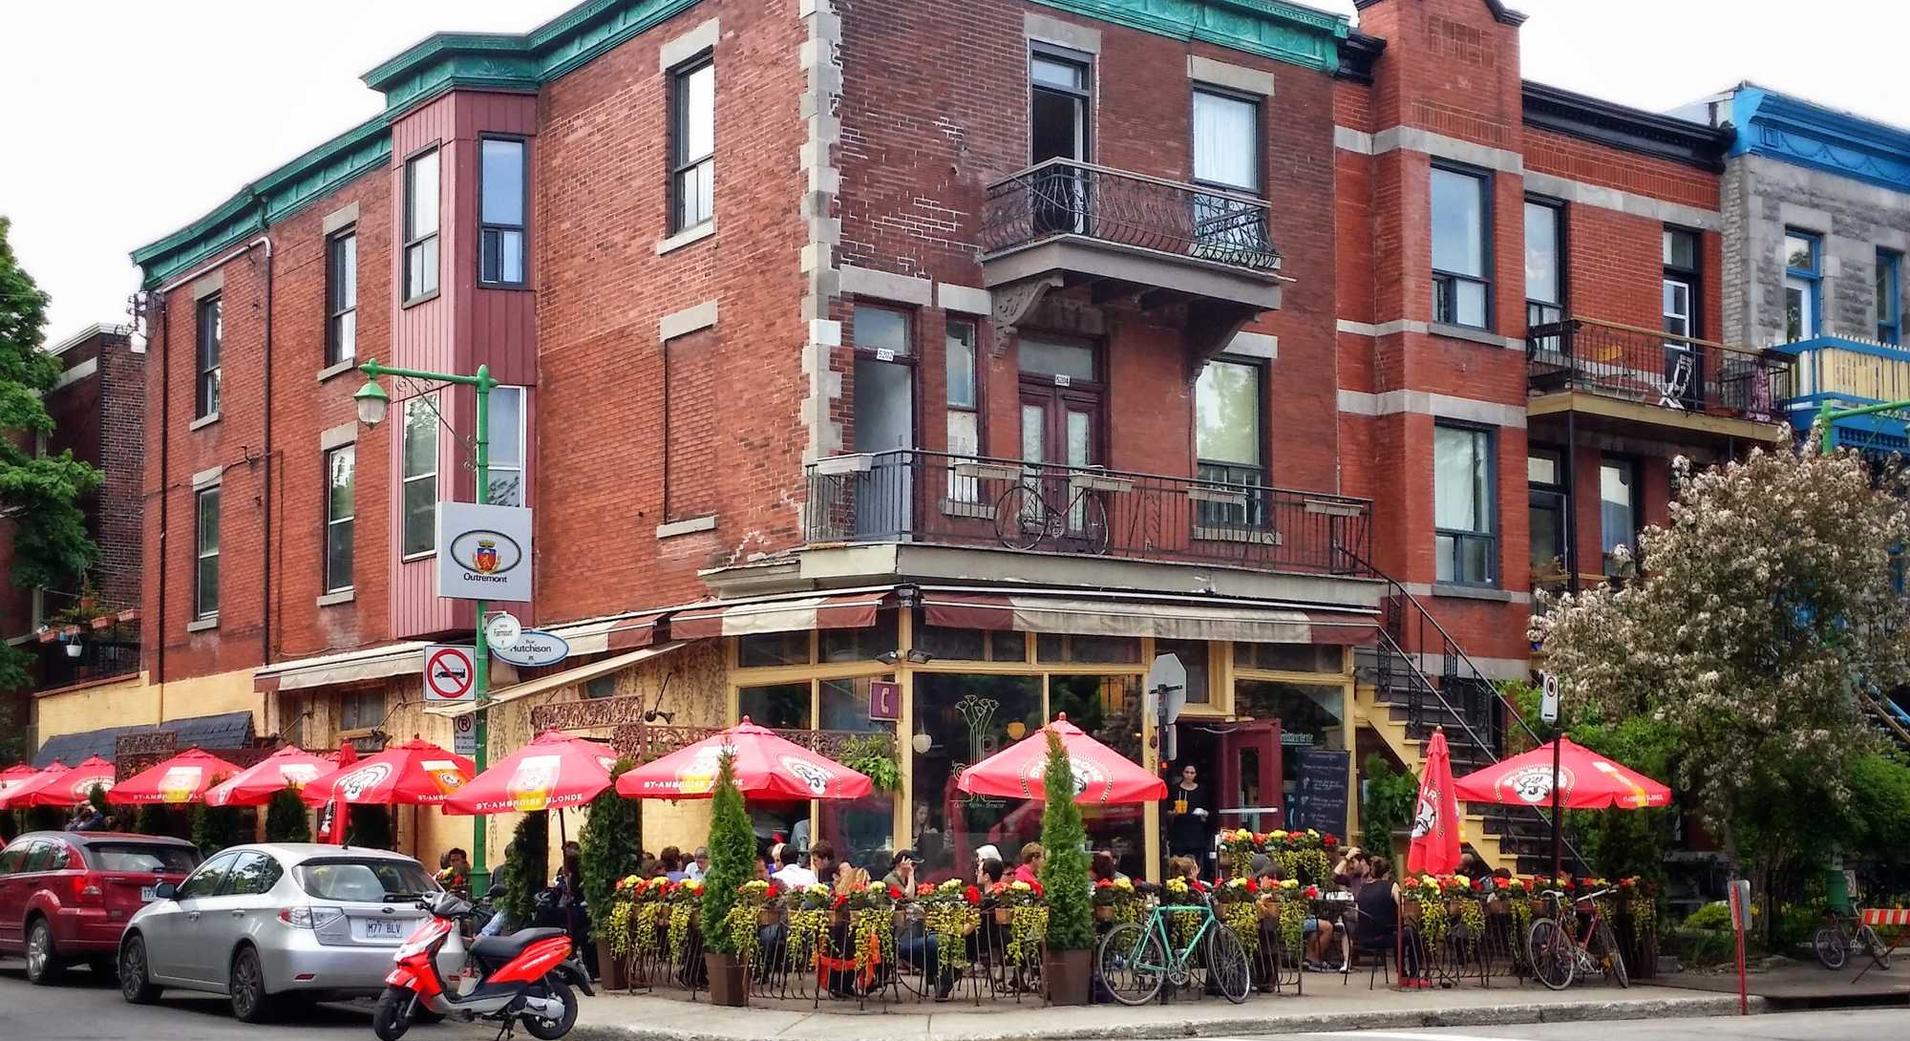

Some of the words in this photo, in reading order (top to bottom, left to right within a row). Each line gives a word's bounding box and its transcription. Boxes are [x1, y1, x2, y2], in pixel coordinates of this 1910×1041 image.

[463, 572, 508, 583] Outremont
[510, 645, 552, 653] Hutchison
[545, 793, 583, 804] BLONDE
[368, 922, 382, 933] M77
[386, 923, 401, 934] BLV
